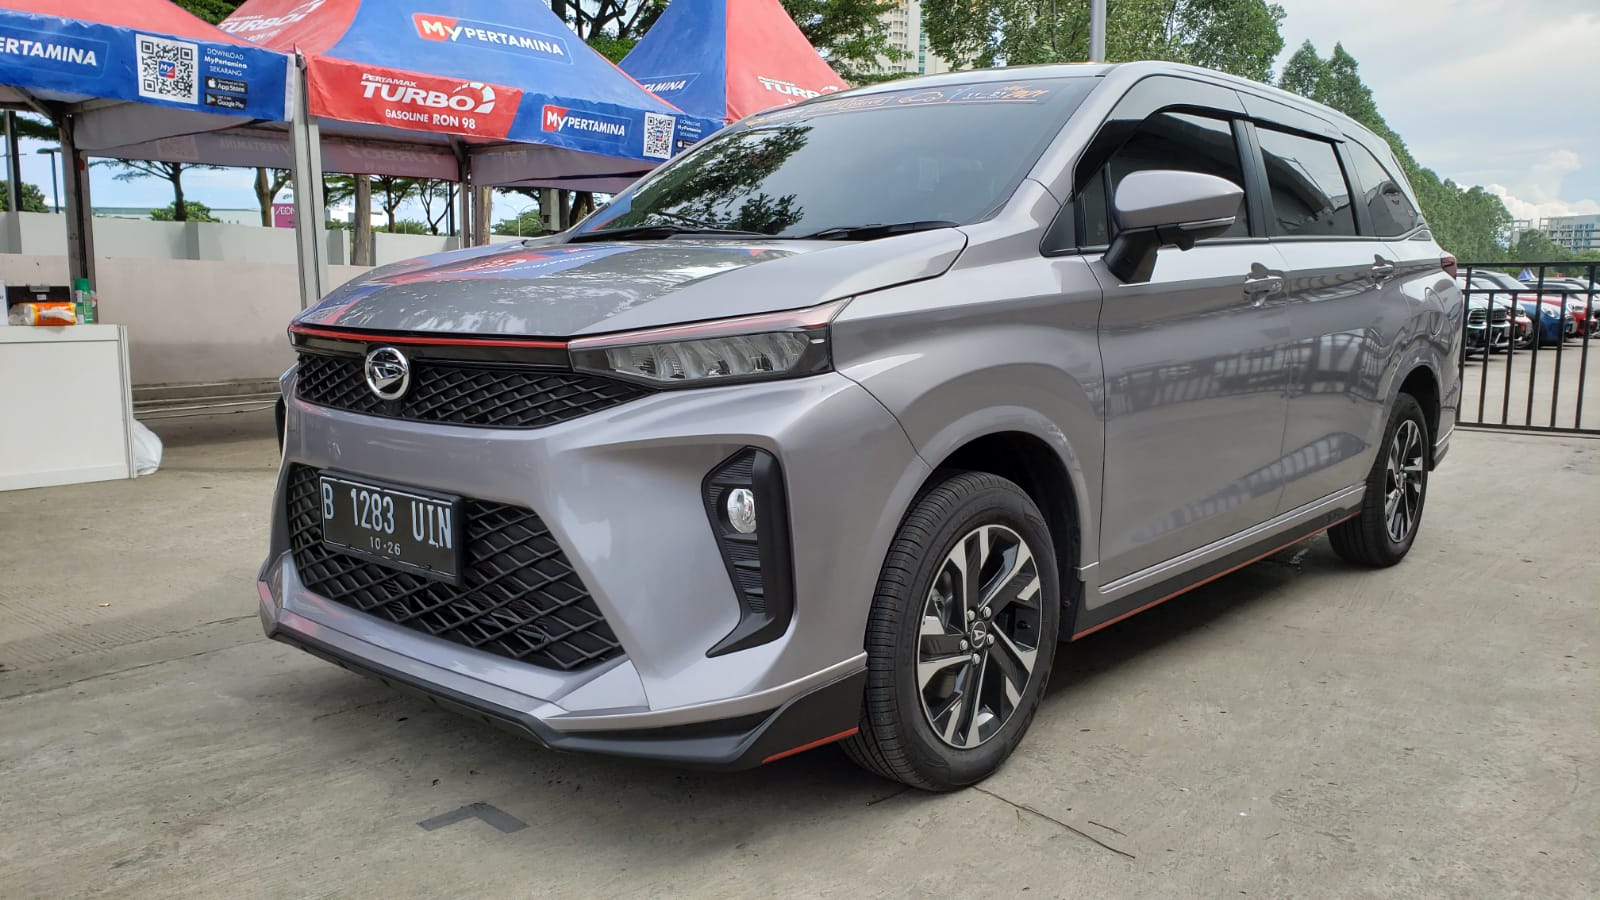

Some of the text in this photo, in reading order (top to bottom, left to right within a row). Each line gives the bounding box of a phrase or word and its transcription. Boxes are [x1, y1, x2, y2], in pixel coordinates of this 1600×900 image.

[207, 48, 244, 60] DOWNLOAD
[362, 73, 417, 88] PERTAMAX
[360, 81, 475, 110] TURBO
[385, 108, 476, 129] GASOLINE RON 98
[323, 483, 452, 549] B 1283 UIN
